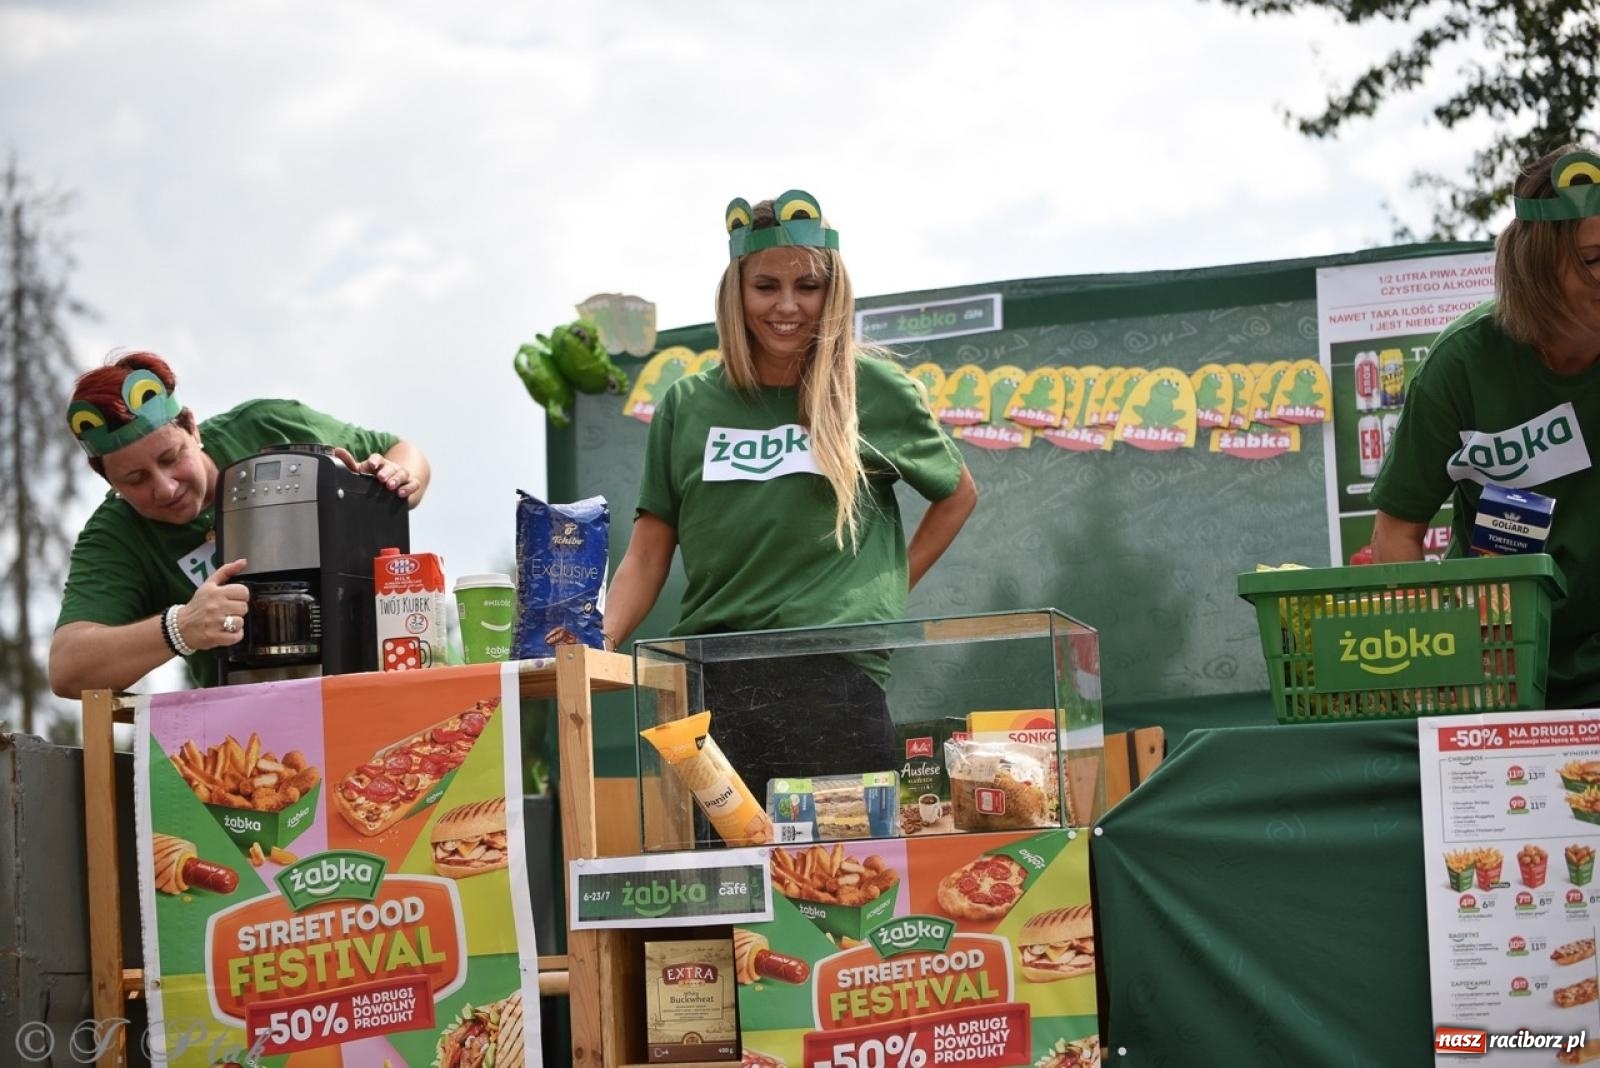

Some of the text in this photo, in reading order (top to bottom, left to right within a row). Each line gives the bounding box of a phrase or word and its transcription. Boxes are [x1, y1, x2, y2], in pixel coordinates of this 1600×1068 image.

[1396, 271, 1427, 283] LITRA
[1430, 268, 1457, 279] PIWA
[1381, 283, 1440, 296] CZYSTEGO
[898, 312, 957, 332] żabka
[1329, 311, 1366, 324] NAWET
[1370, 308, 1398, 319] TAKA
[1402, 304, 1436, 316] ILOŚĆ
[1376, 319, 1401, 331] JEST
[939, 407, 984, 420] żabka
[1009, 408, 1056, 424] żabka
[1277, 405, 1325, 419] żabka
[1123, 425, 1187, 443] żabka
[1219, 430, 1291, 449] żabka
[1361, 429, 1381, 460] EB
[532, 558, 599, 580] Exclusive
[379, 596, 431, 616] TWÓJ KUBEK
[1339, 628, 1456, 662] żabka
[1008, 731, 1057, 744] SONKO
[1450, 723, 1600, 748] -50% NA DRUGI DO
[901, 762, 940, 778] Auslese
[704, 786, 733, 809] Panini
[224, 815, 261, 832] żabka
[289, 858, 372, 894] żabka
[621, 880, 707, 906] żabka
[719, 882, 747, 896] café
[237, 896, 425, 952] STREET FOOD
[878, 921, 945, 945] żabka
[227, 926, 446, 998] FESTIVAL
[837, 949, 985, 988] STREET FOOD
[667, 966, 714, 980] EXTRA
[352, 987, 414, 1007] NA DRUGI
[670, 996, 714, 1004] Buckwheat
[829, 971, 999, 1021] FESTIVAL
[353, 998, 416, 1019] DOWOLNY
[254, 1002, 349, 1045] -50%
[354, 1010, 414, 1030] PRODUKT
[934, 1016, 1008, 1038] NA DRUGI
[814, 1032, 927, 1068] -50%
[934, 1029, 1010, 1051] DOWOLNY
[934, 1043, 1006, 1064] PRODUKT
